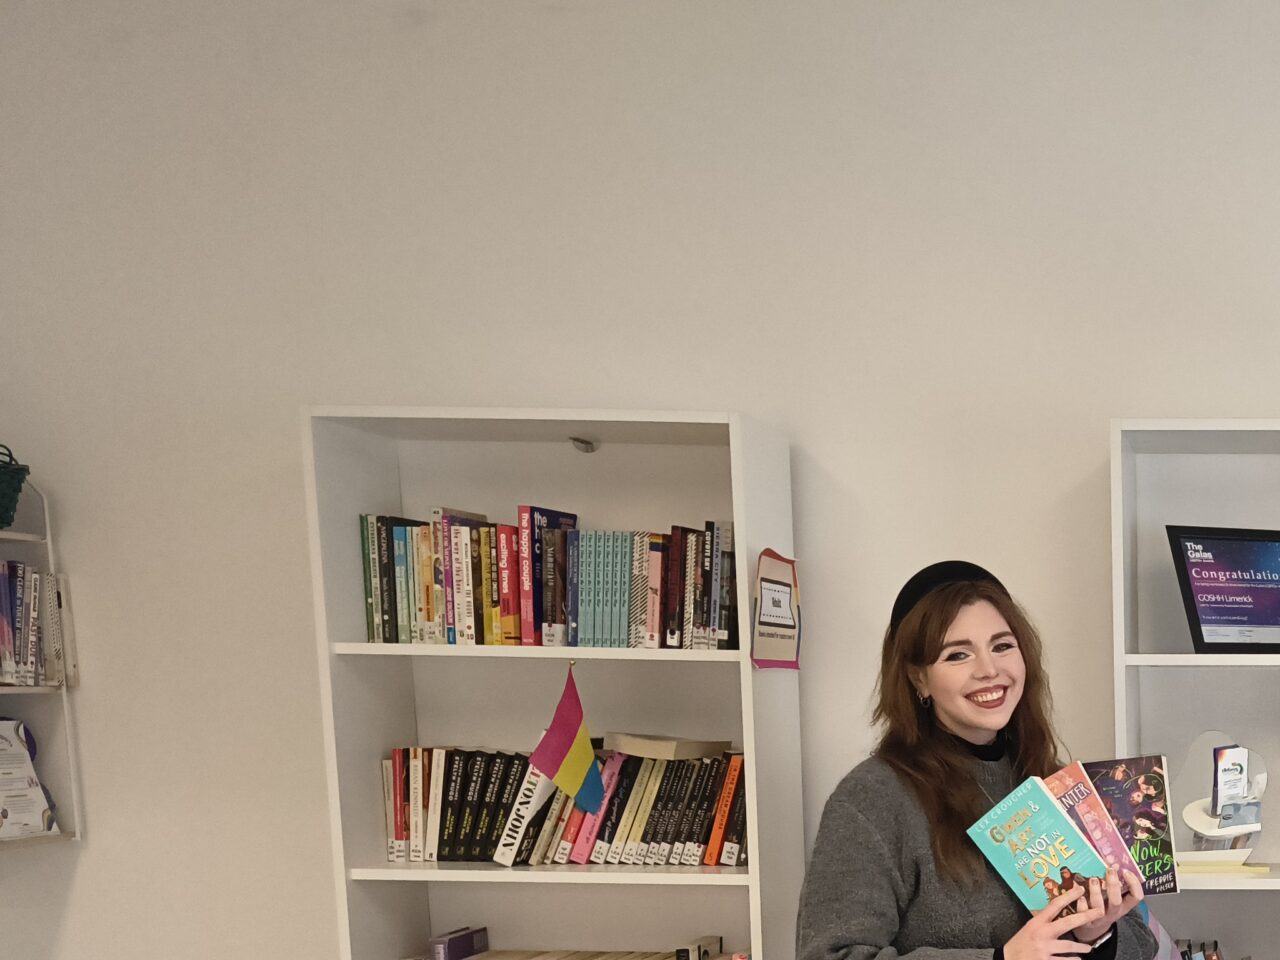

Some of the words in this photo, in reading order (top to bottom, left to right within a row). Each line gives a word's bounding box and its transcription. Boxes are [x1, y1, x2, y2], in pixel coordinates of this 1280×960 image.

[499, 533, 508, 568] exciting
[1185, 542, 1203, 551] The
[523, 560, 531, 591] couple
[1226, 595, 1253, 603] Limerick
[502, 808, 525, 851] JOHN
[989, 809, 1033, 844] GWEN
[1030, 800, 1040, 814] &
[1007, 825, 1035, 855] ART
[1014, 854, 1029, 871] ARE
[1027, 834, 1049, 857] NOT
[1050, 830, 1061, 840] IN
[1017, 836, 1076, 889] LOVE
